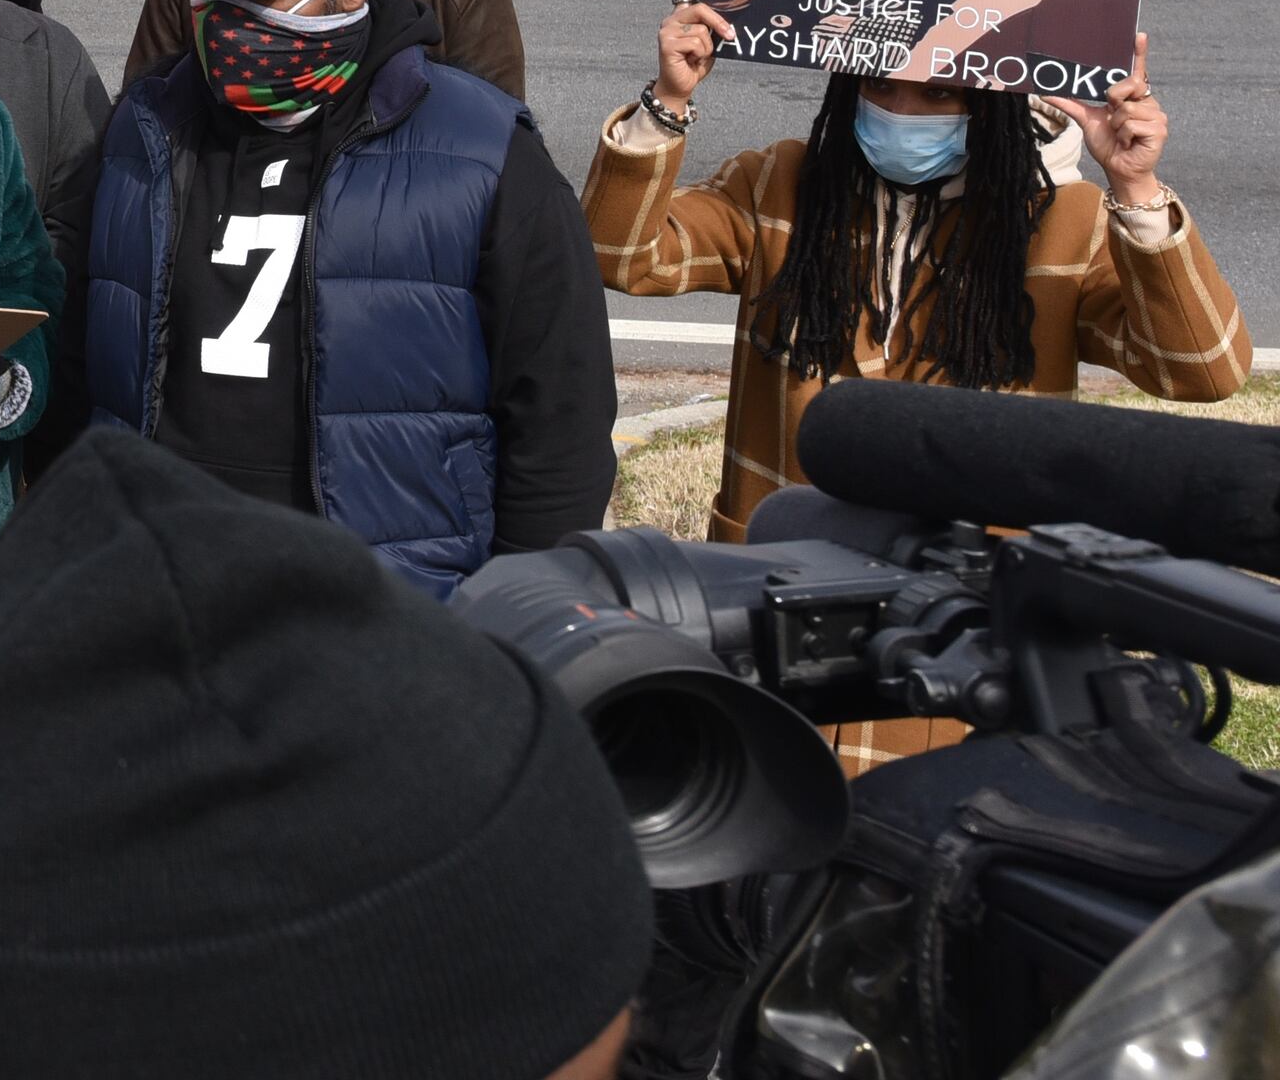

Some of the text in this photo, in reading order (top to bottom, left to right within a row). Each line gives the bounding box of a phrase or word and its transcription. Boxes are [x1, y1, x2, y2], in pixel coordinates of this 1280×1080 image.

[936, 4, 1002, 34] FOR
[716, 24, 912, 74] AYSHARD
[201, 214, 306, 378] 7
